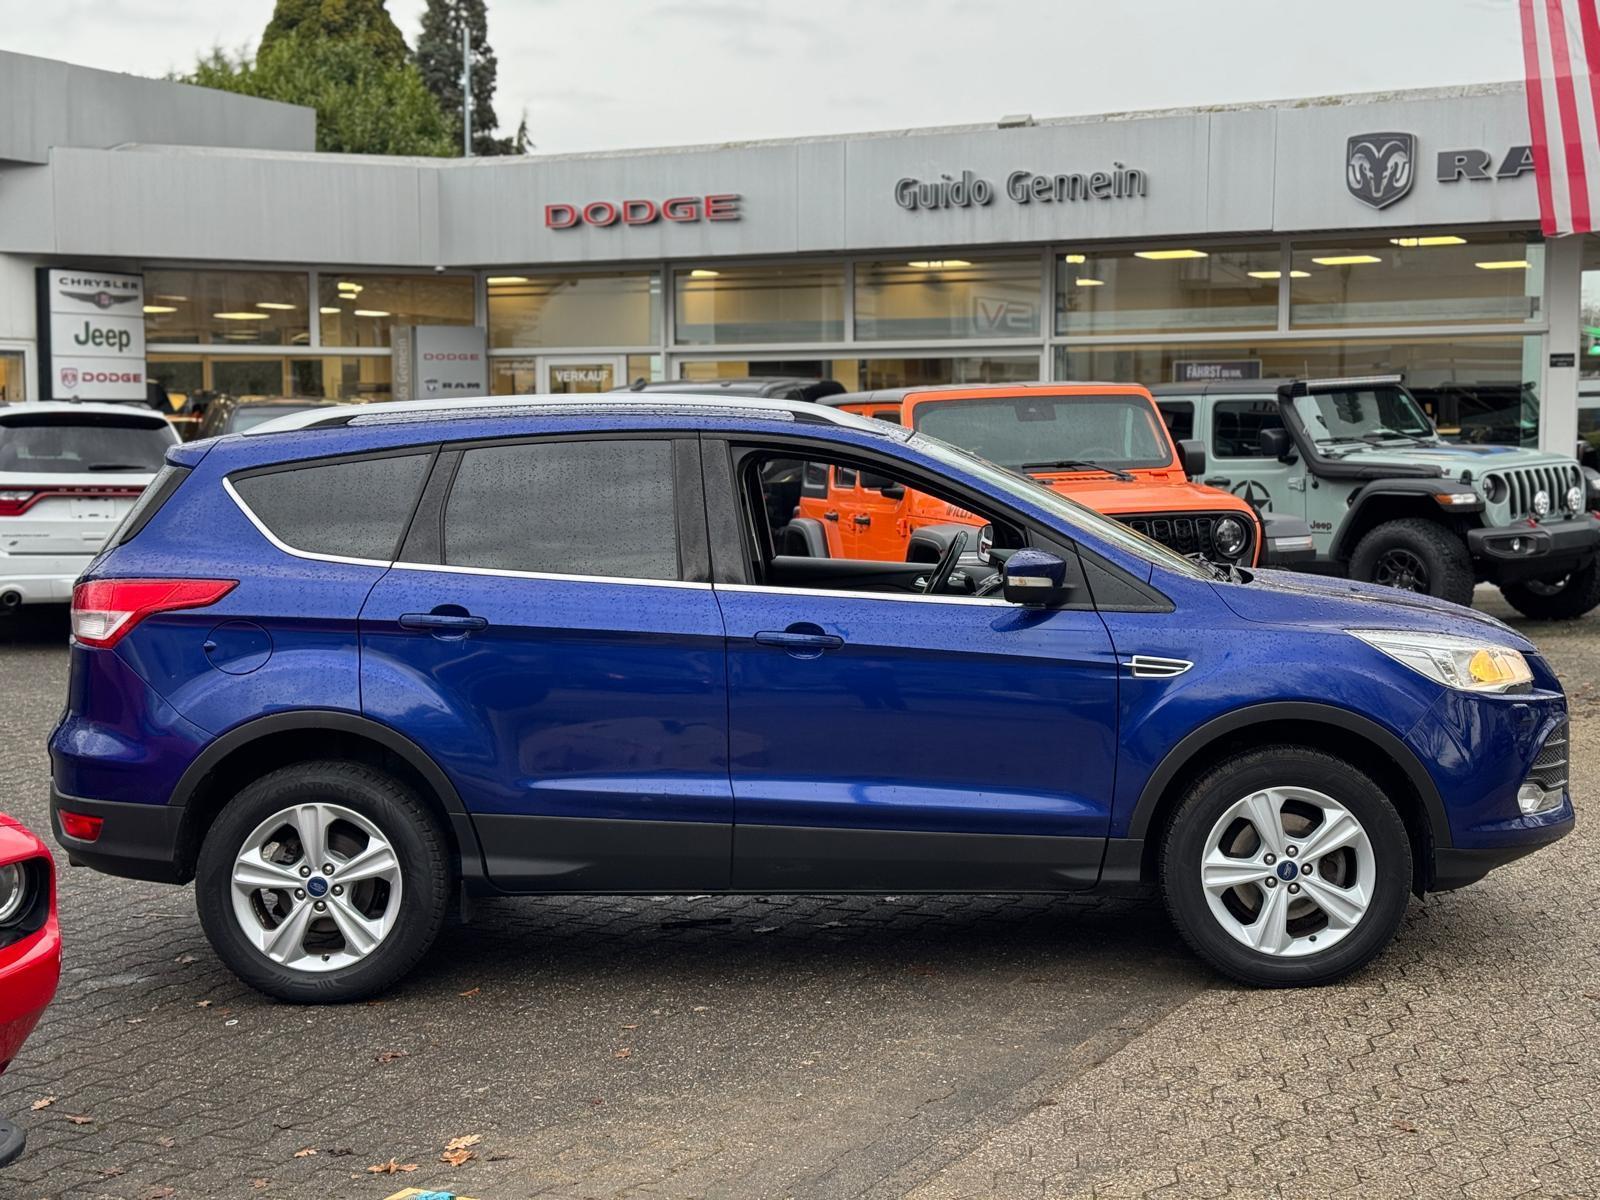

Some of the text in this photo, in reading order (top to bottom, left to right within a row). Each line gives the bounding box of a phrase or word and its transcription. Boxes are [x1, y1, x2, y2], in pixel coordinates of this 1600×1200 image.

[1436, 145, 1537, 182] RA
[894, 161, 1148, 211] Guido Gemein
[544, 193, 742, 231] DODGE
[59, 277, 138, 289] CHRYSLER
[74, 320, 131, 353] Jeep
[424, 353, 480, 361] DODGE
[82, 372, 142, 383] DODGE
[555, 369, 610, 382] VERKAUF
[1310, 520, 1332, 531] Jeep
